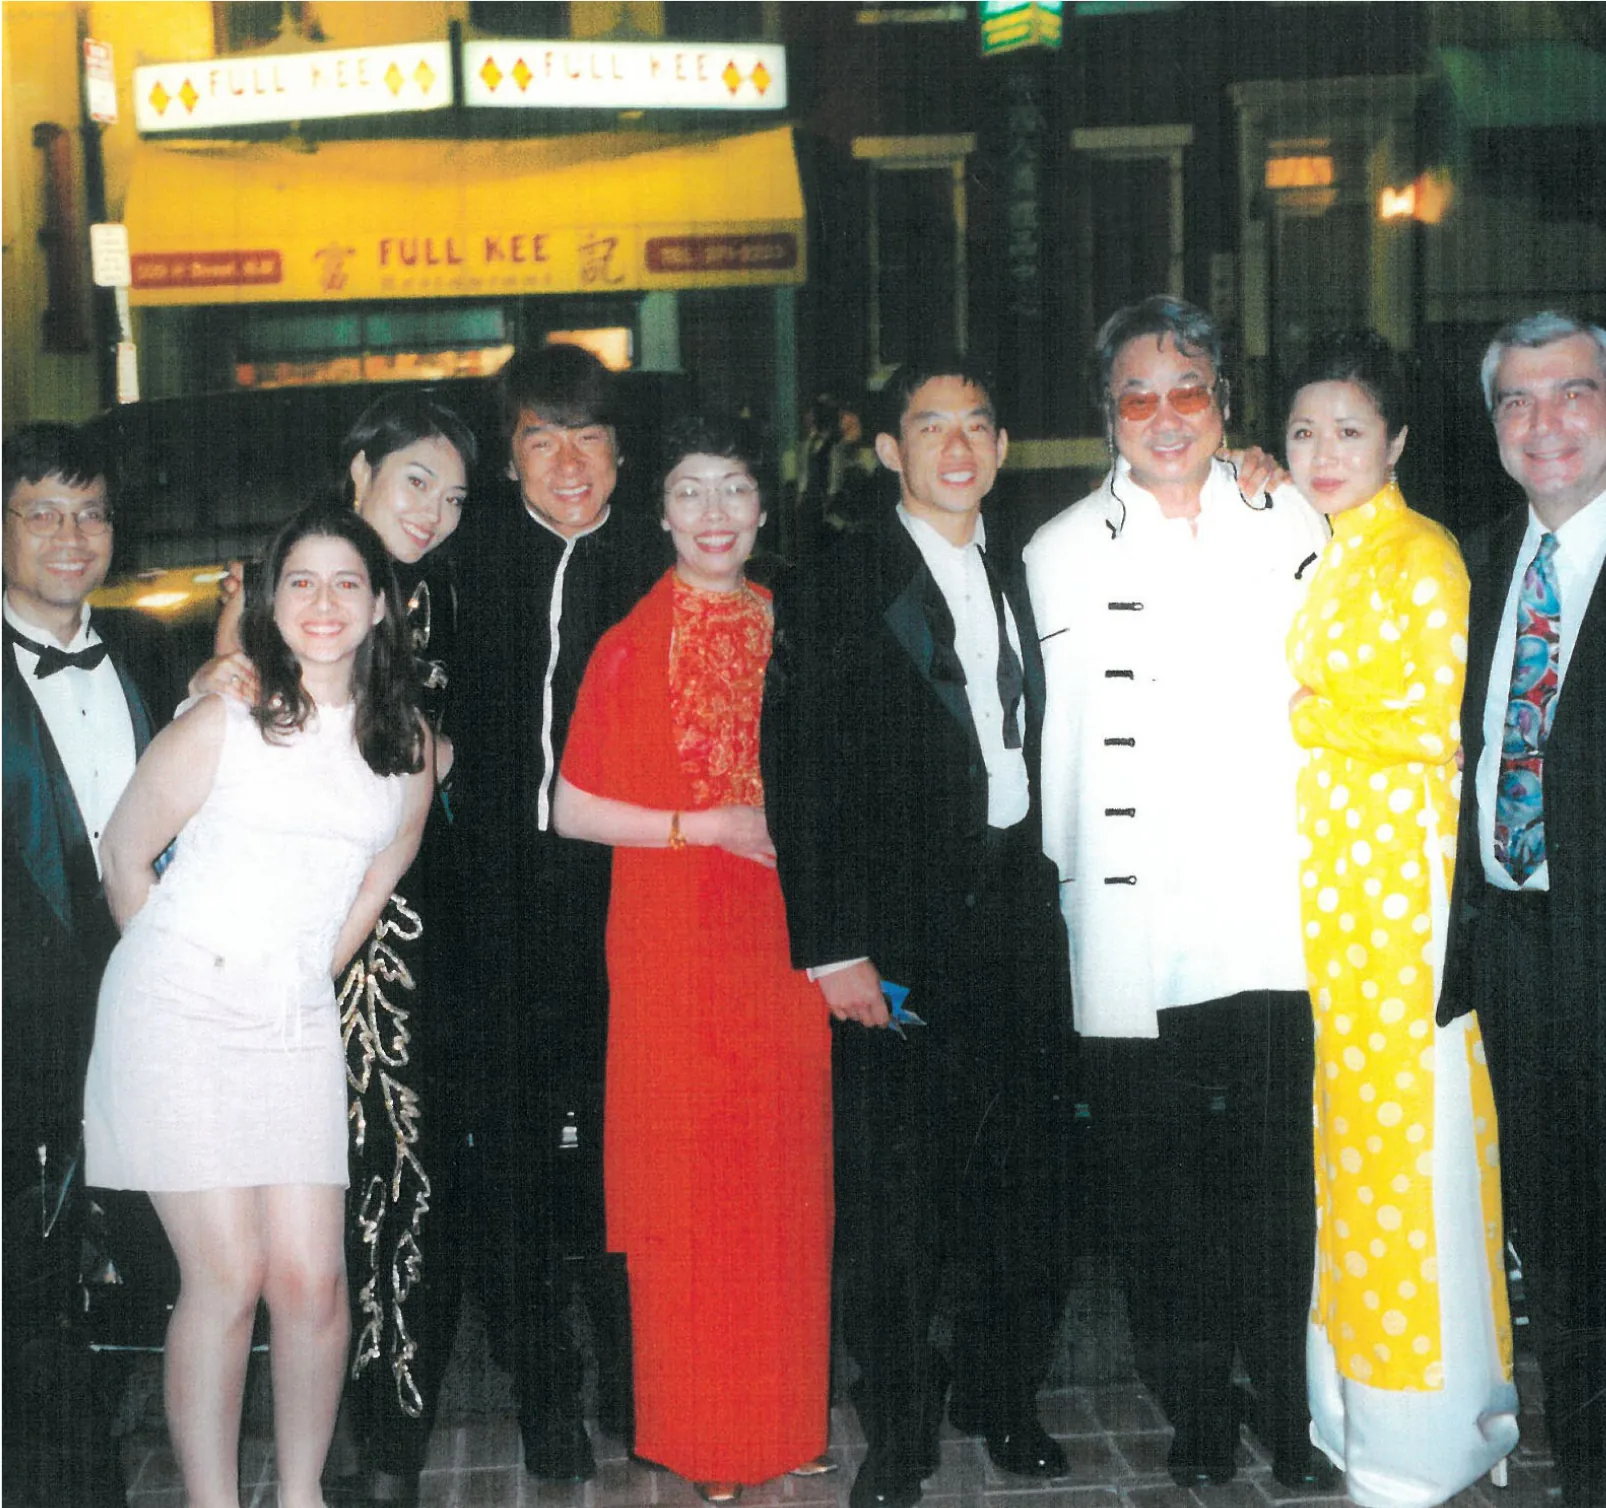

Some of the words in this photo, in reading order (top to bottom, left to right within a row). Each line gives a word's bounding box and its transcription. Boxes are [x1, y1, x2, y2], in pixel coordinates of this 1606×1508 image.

[208, 64, 286, 97] FULL
[544, 51, 624, 81] FULL
[379, 236, 464, 266] FULL
[485, 233, 549, 263] KEE
